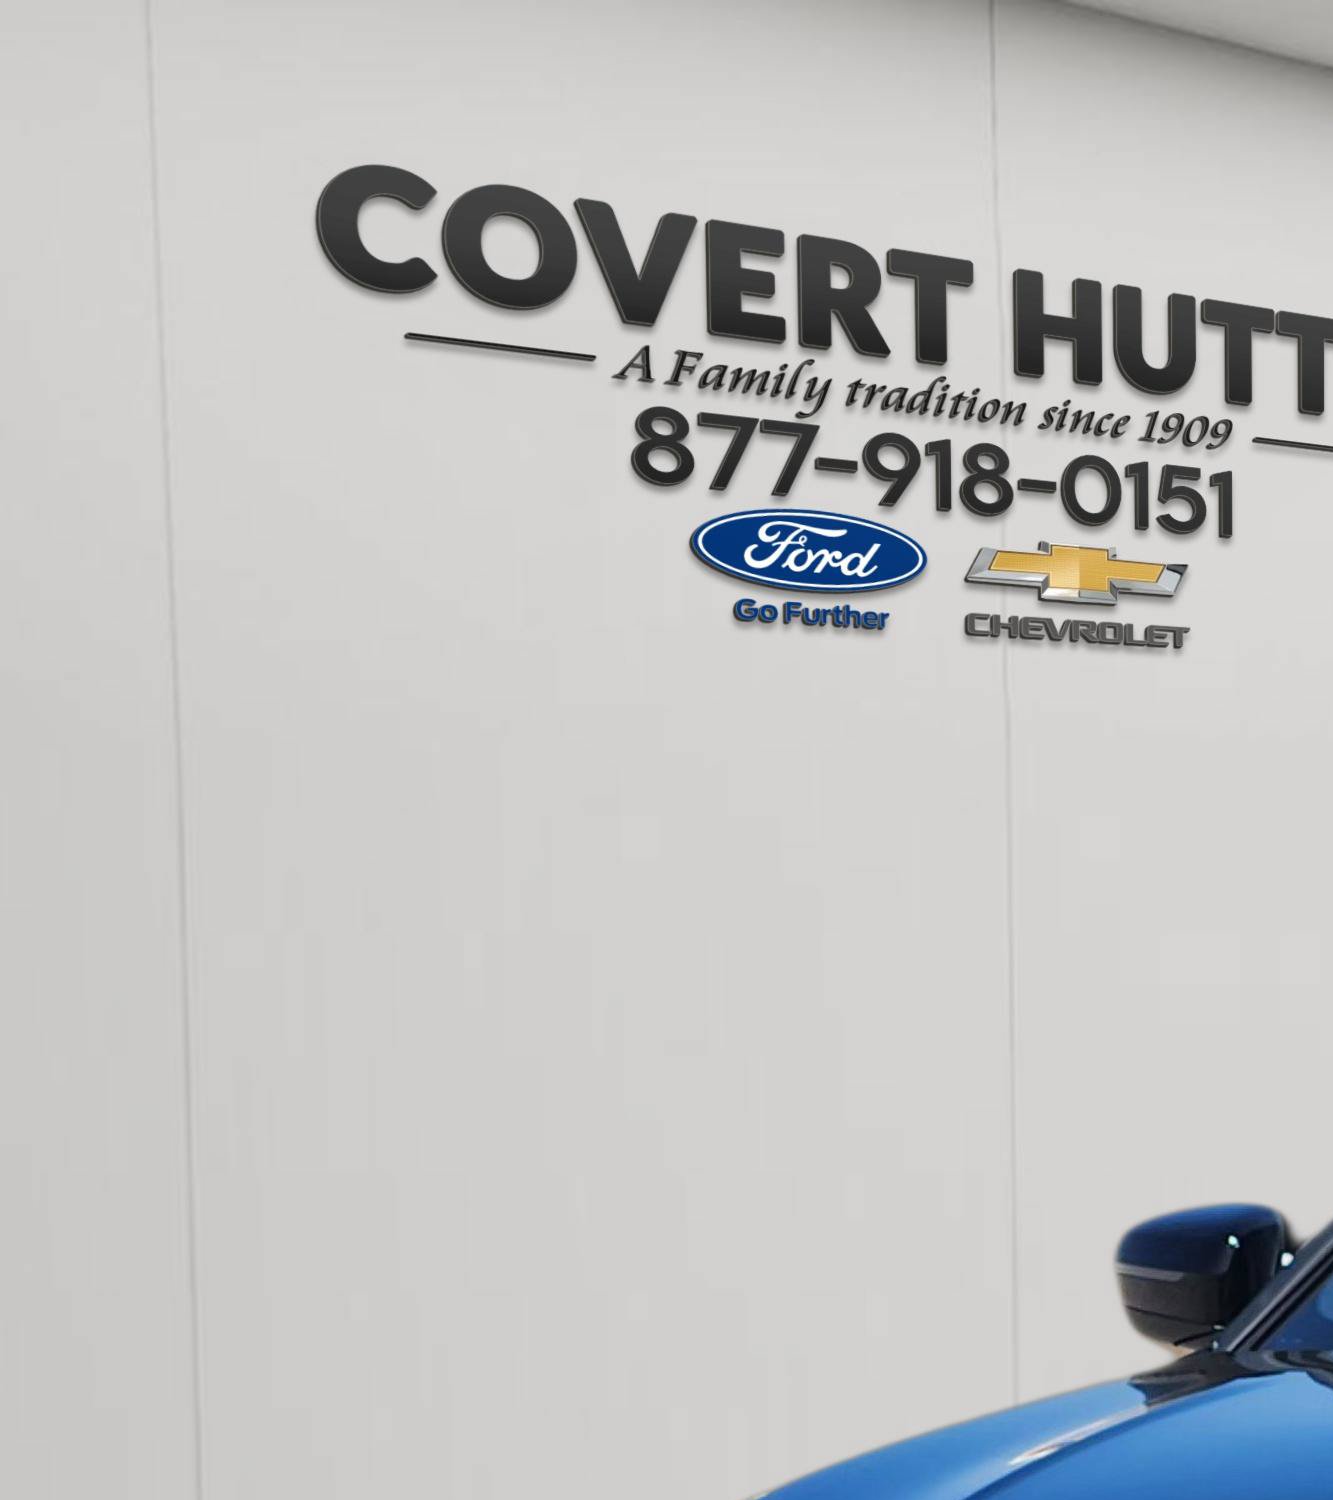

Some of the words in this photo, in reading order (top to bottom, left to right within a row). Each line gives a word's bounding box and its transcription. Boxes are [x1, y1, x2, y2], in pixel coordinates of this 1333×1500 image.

[316, 163, 974, 365] COVERT
[611, 344, 656, 384] A
[664, 349, 833, 419] Family
[844, 375, 1028, 427] tradition
[1037, 399, 1132, 439] since
[1137, 409, 1233, 450] 1909
[631, 405, 1233, 539] 877-918-0151
[743, 519, 881, 580] Ford
[733, 597, 778, 626] Go
[783, 601, 890, 631] Further
[963, 612, 1191, 649] CHEVROLET
